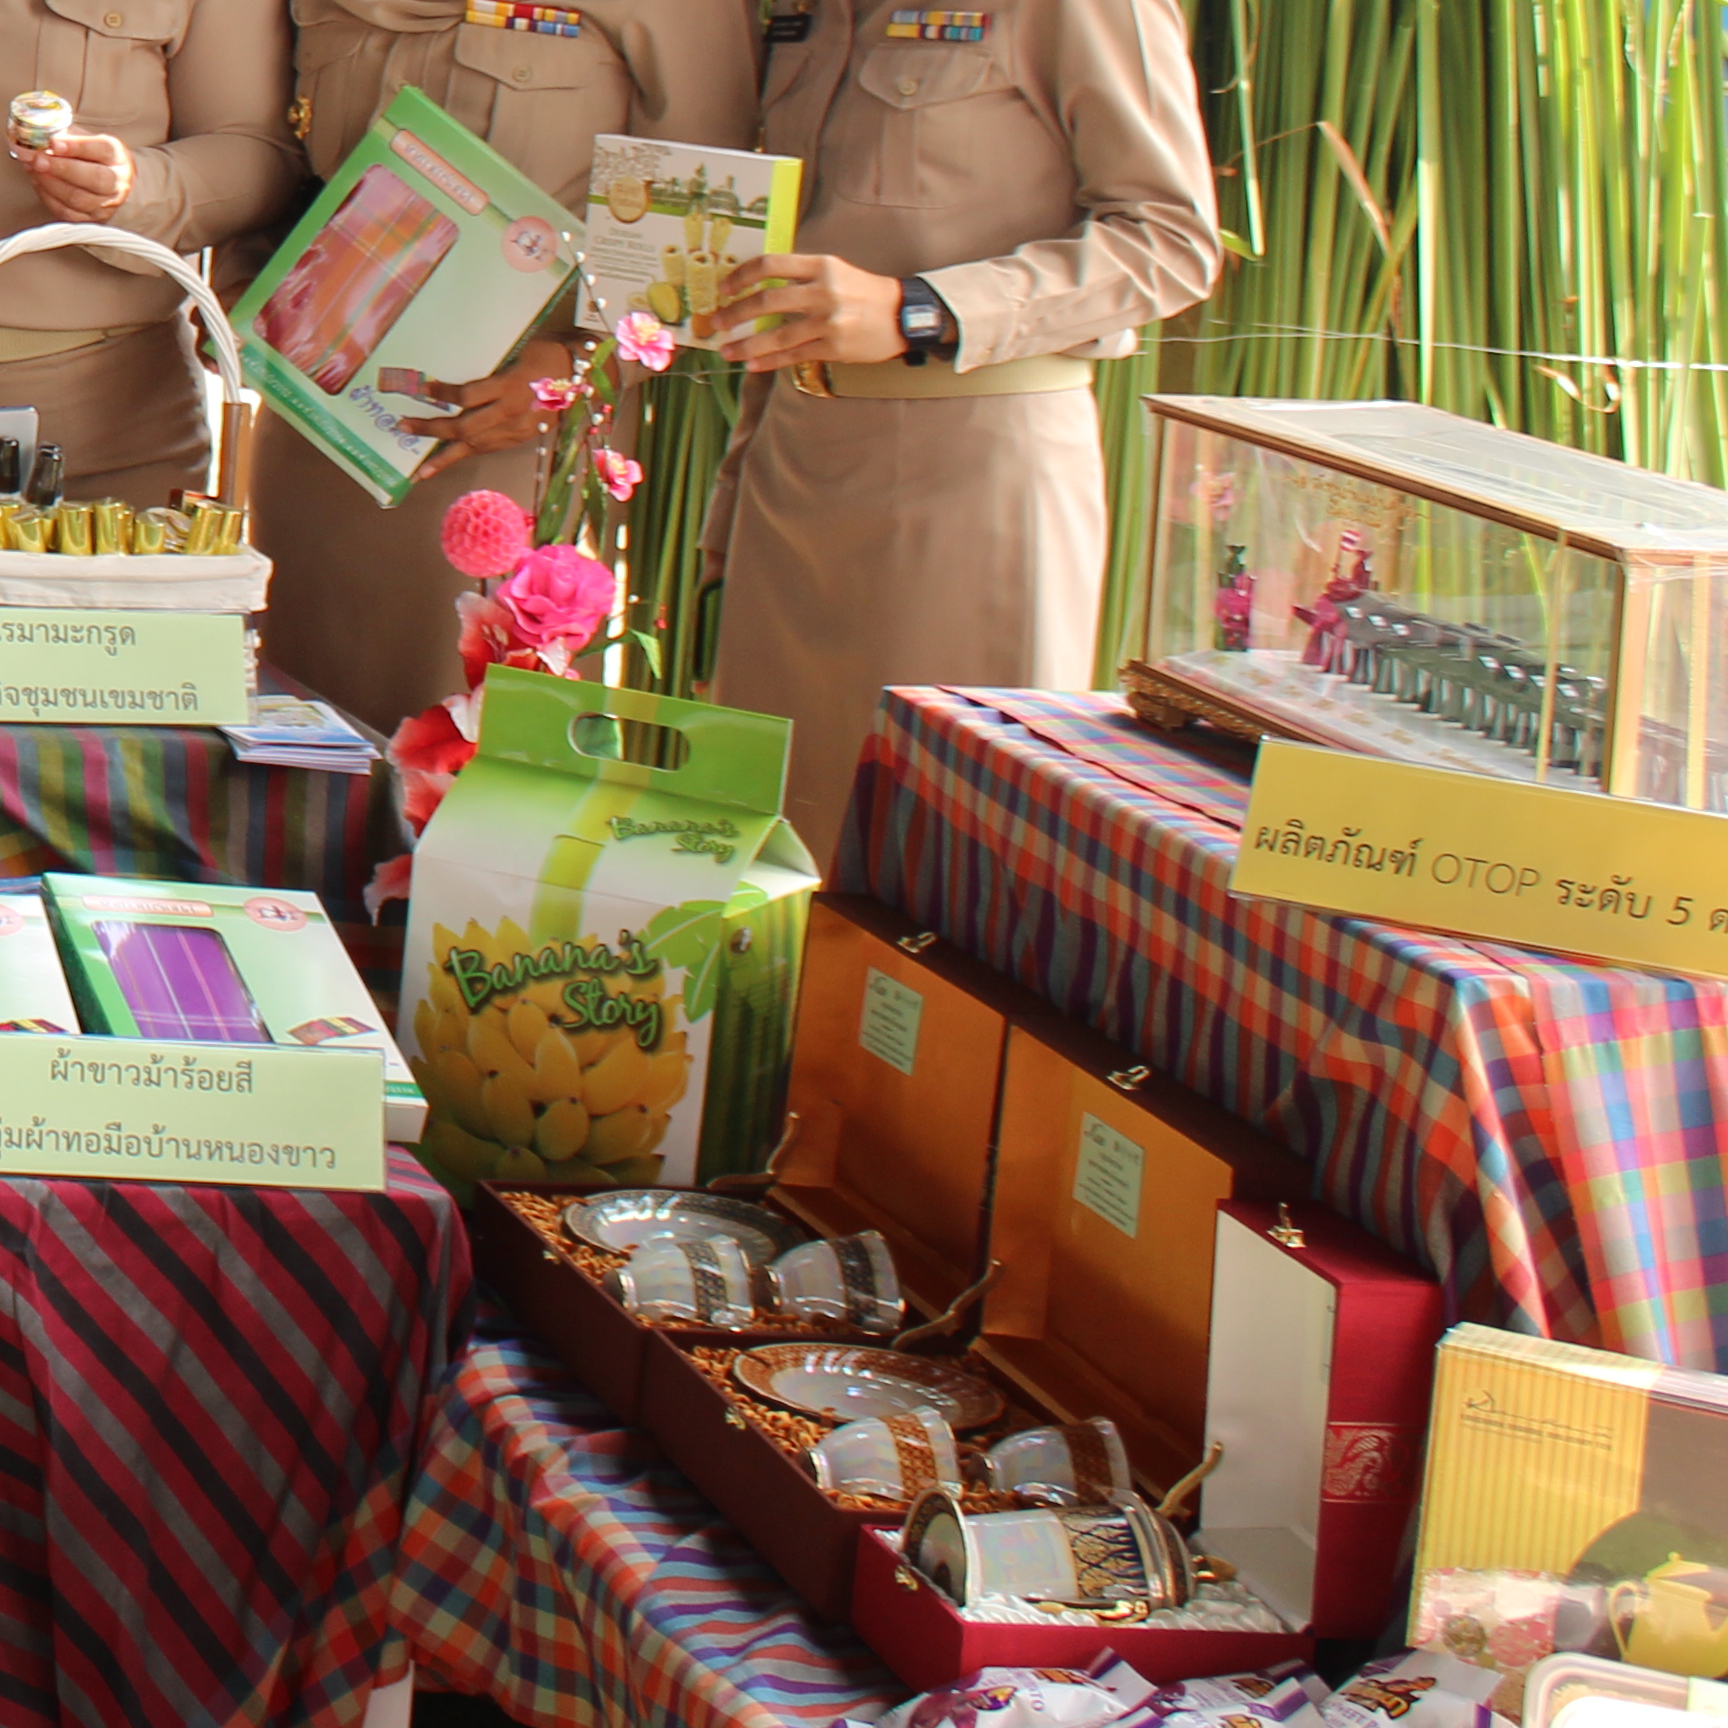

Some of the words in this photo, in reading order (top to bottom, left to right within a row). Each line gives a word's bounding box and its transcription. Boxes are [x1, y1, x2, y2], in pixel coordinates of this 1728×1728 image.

[605, 816, 739, 841] Banana's
[669, 832, 735, 864] Story
[1254, 818, 1423, 878] ผลิตภัณฑ์
[1431, 852, 1540, 898] OTOP
[1555, 874, 1654, 920] ระดับ
[1667, 896, 1696, 927] 5
[447, 927, 660, 1012] Banana's
[562, 980, 664, 1049] Story
[50, 1048, 254, 1094] ผ้าขาวม้าร้อยสี
